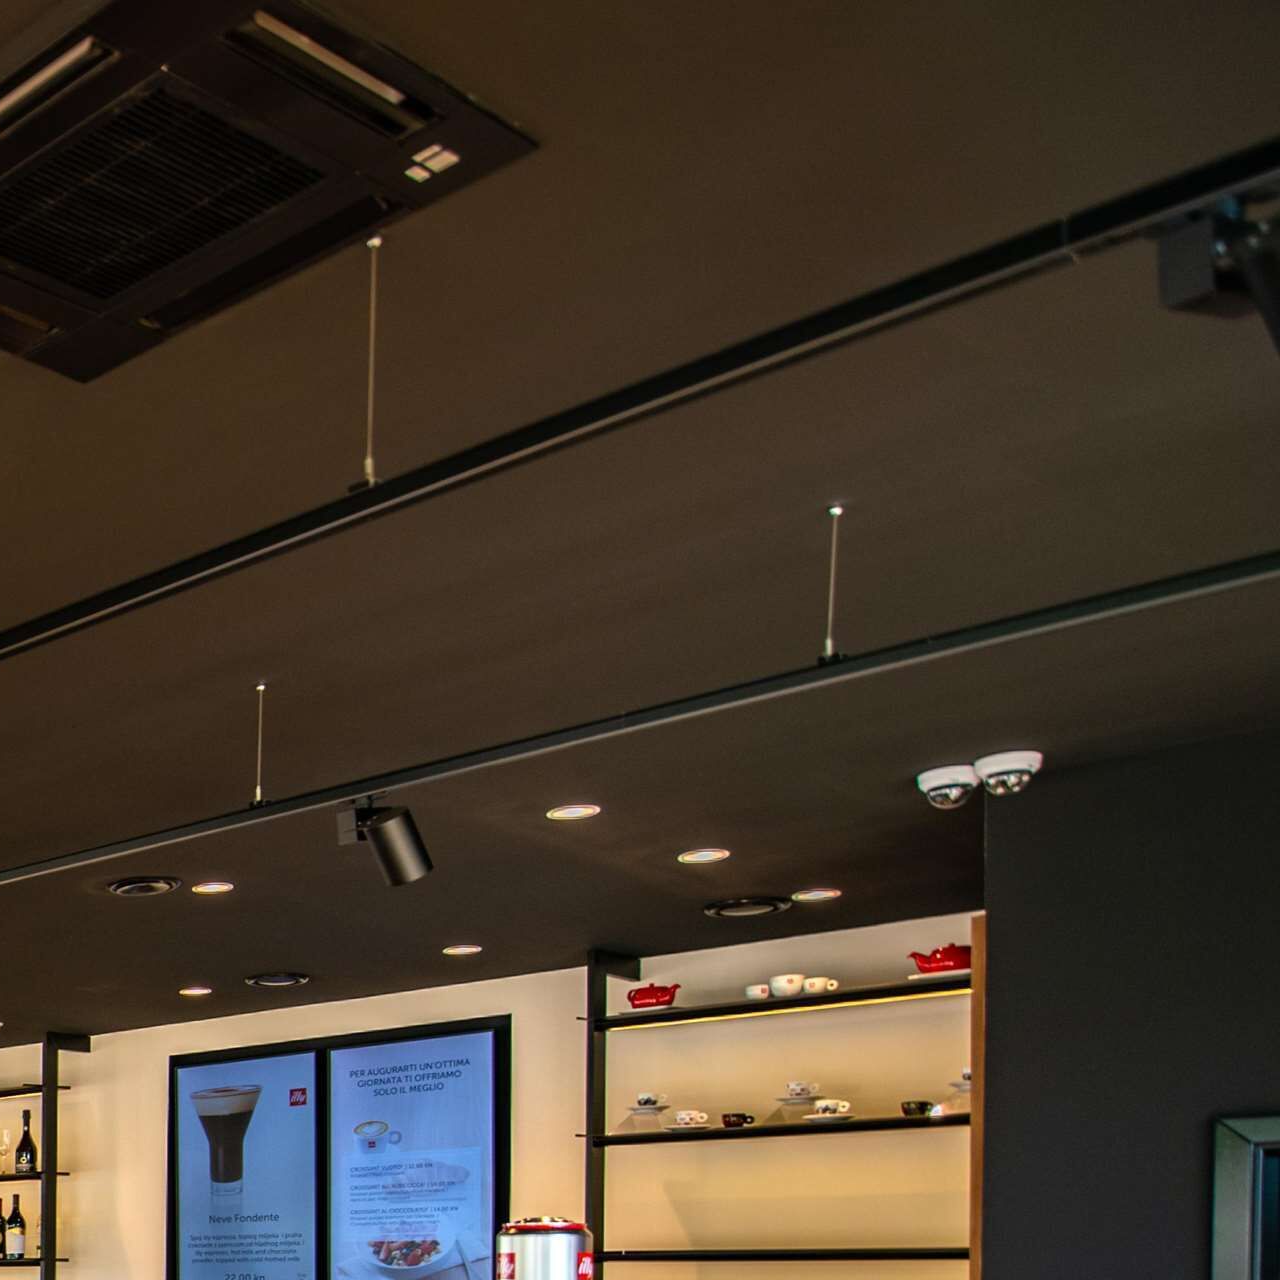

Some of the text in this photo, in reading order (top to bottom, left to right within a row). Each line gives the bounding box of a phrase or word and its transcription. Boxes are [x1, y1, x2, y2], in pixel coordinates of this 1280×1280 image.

[349, 1059, 470, 1078] PER AUGURARTI UN'OTTIMA
[357, 1070, 462, 1088] GIORNATA TI OFFRIAMO
[290, 1089, 307, 1105] illy
[373, 1083, 444, 1096] SOLO IL MEGLIO
[208, 1213, 280, 1224] Neve Fondente
[578, 1255, 593, 1279] illy
